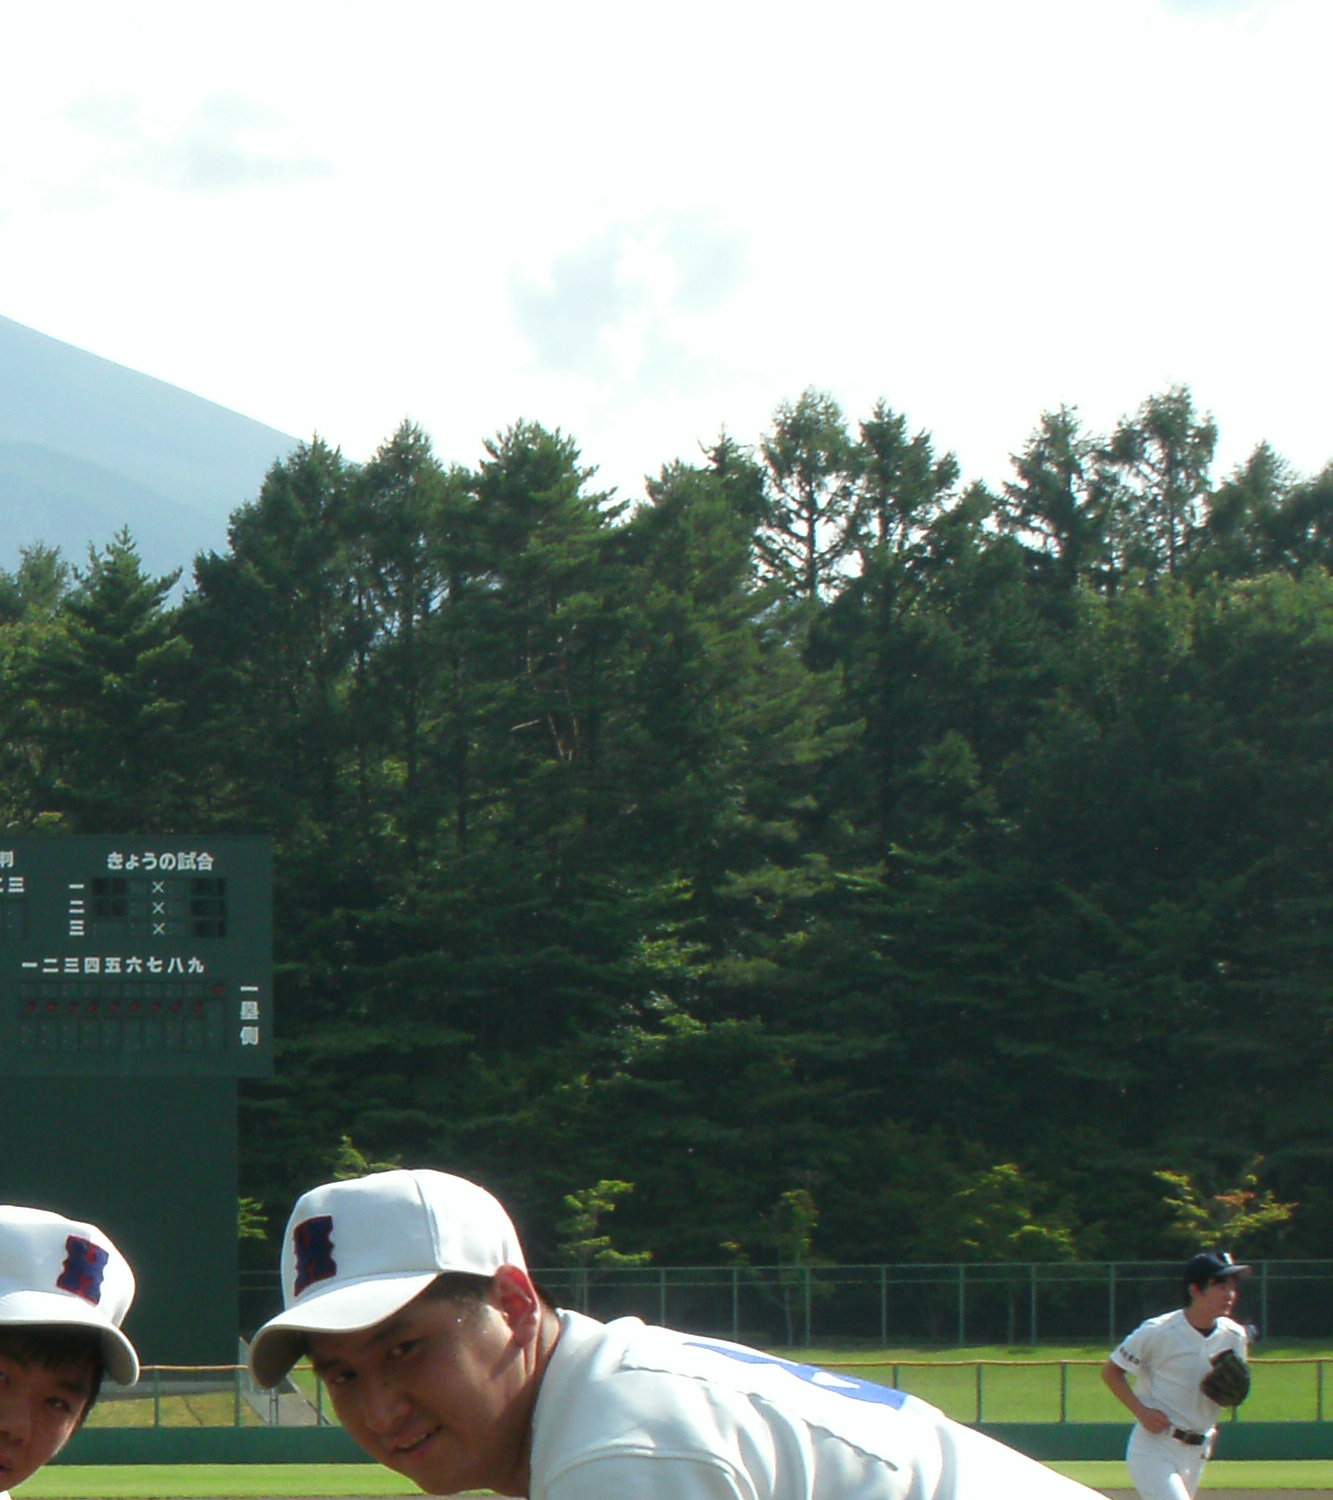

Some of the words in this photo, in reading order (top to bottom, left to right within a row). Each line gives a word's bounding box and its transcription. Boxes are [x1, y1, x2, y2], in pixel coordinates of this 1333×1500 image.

[107, 851, 214, 871] きょうの試合
